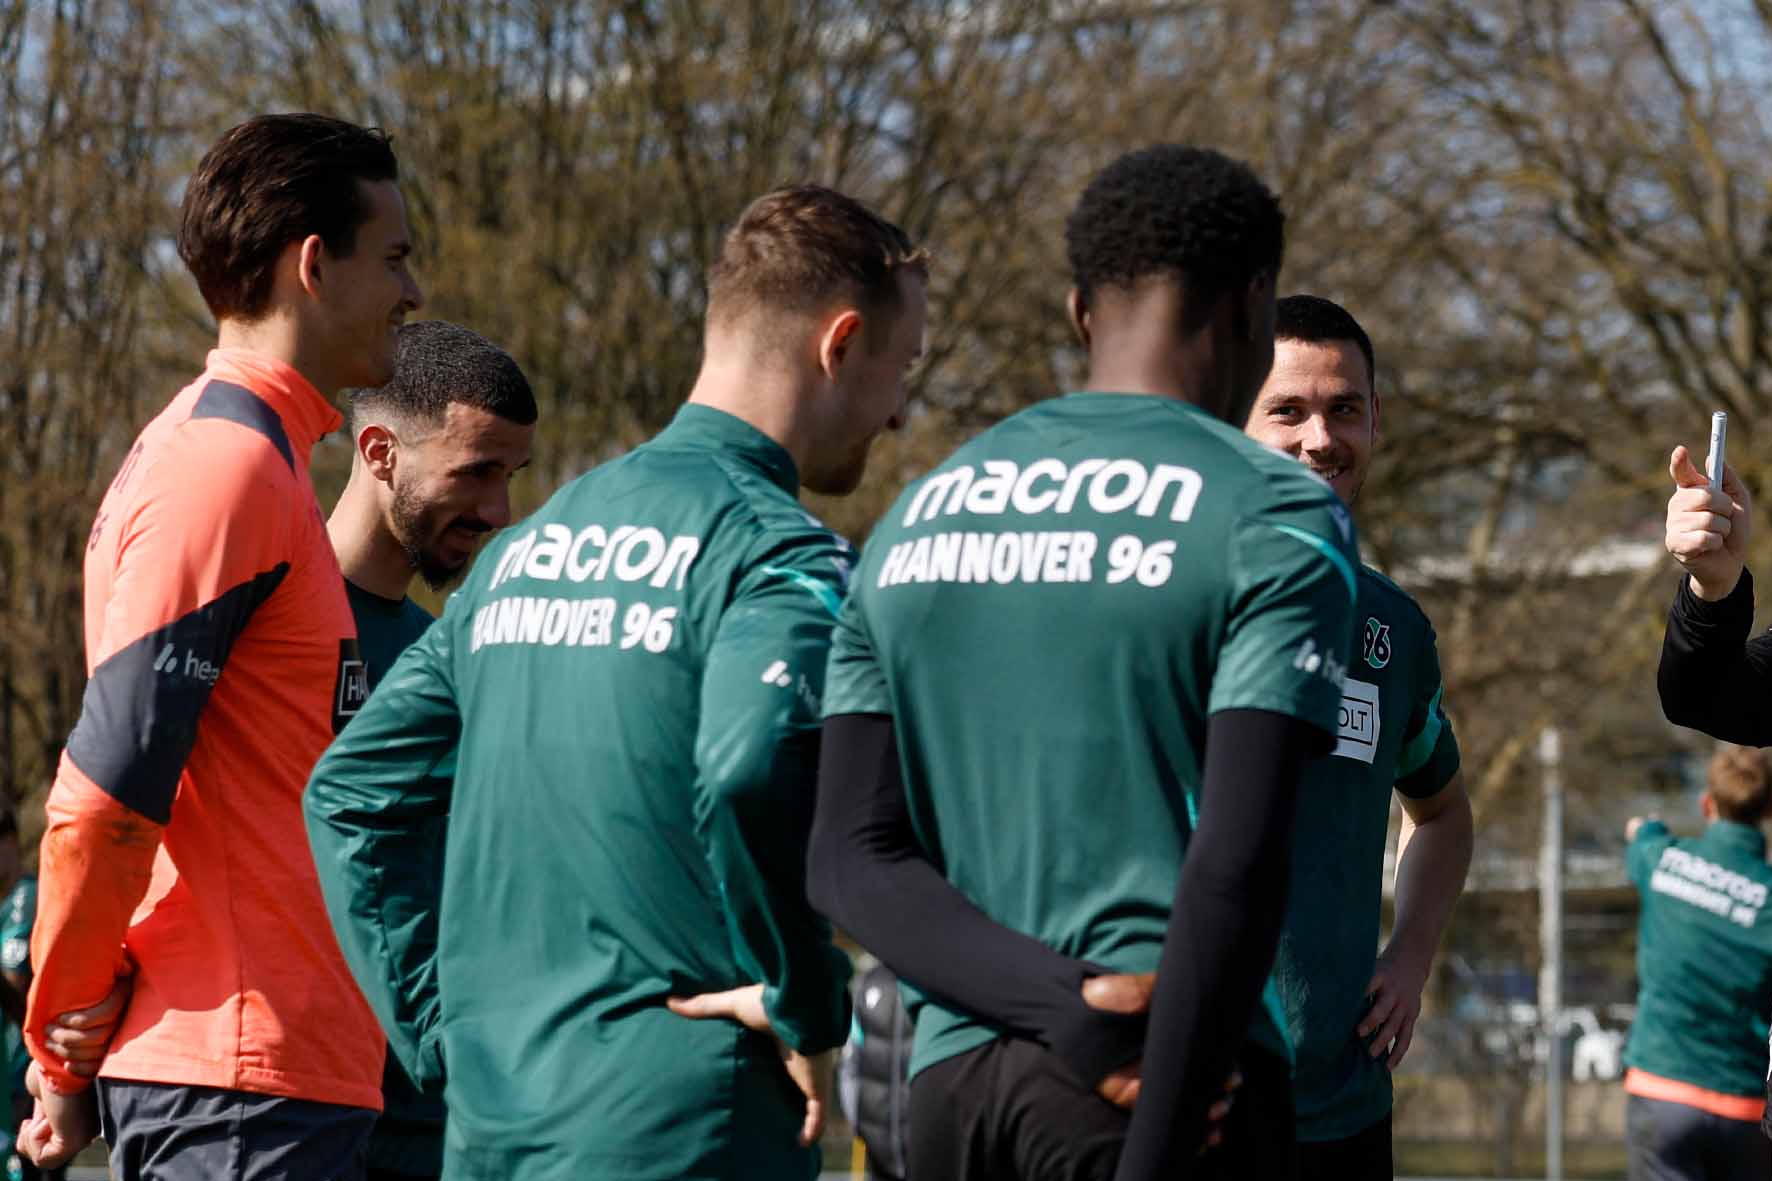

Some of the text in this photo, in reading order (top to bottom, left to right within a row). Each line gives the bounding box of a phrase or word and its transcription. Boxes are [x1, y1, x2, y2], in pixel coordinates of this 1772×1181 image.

[902, 458, 1203, 528] macron
[489, 523, 701, 591] macron
[877, 531, 1177, 589] HANNOVER 96
[471, 597, 679, 654] HANNOVER 96
[1364, 619, 1391, 667] 96
